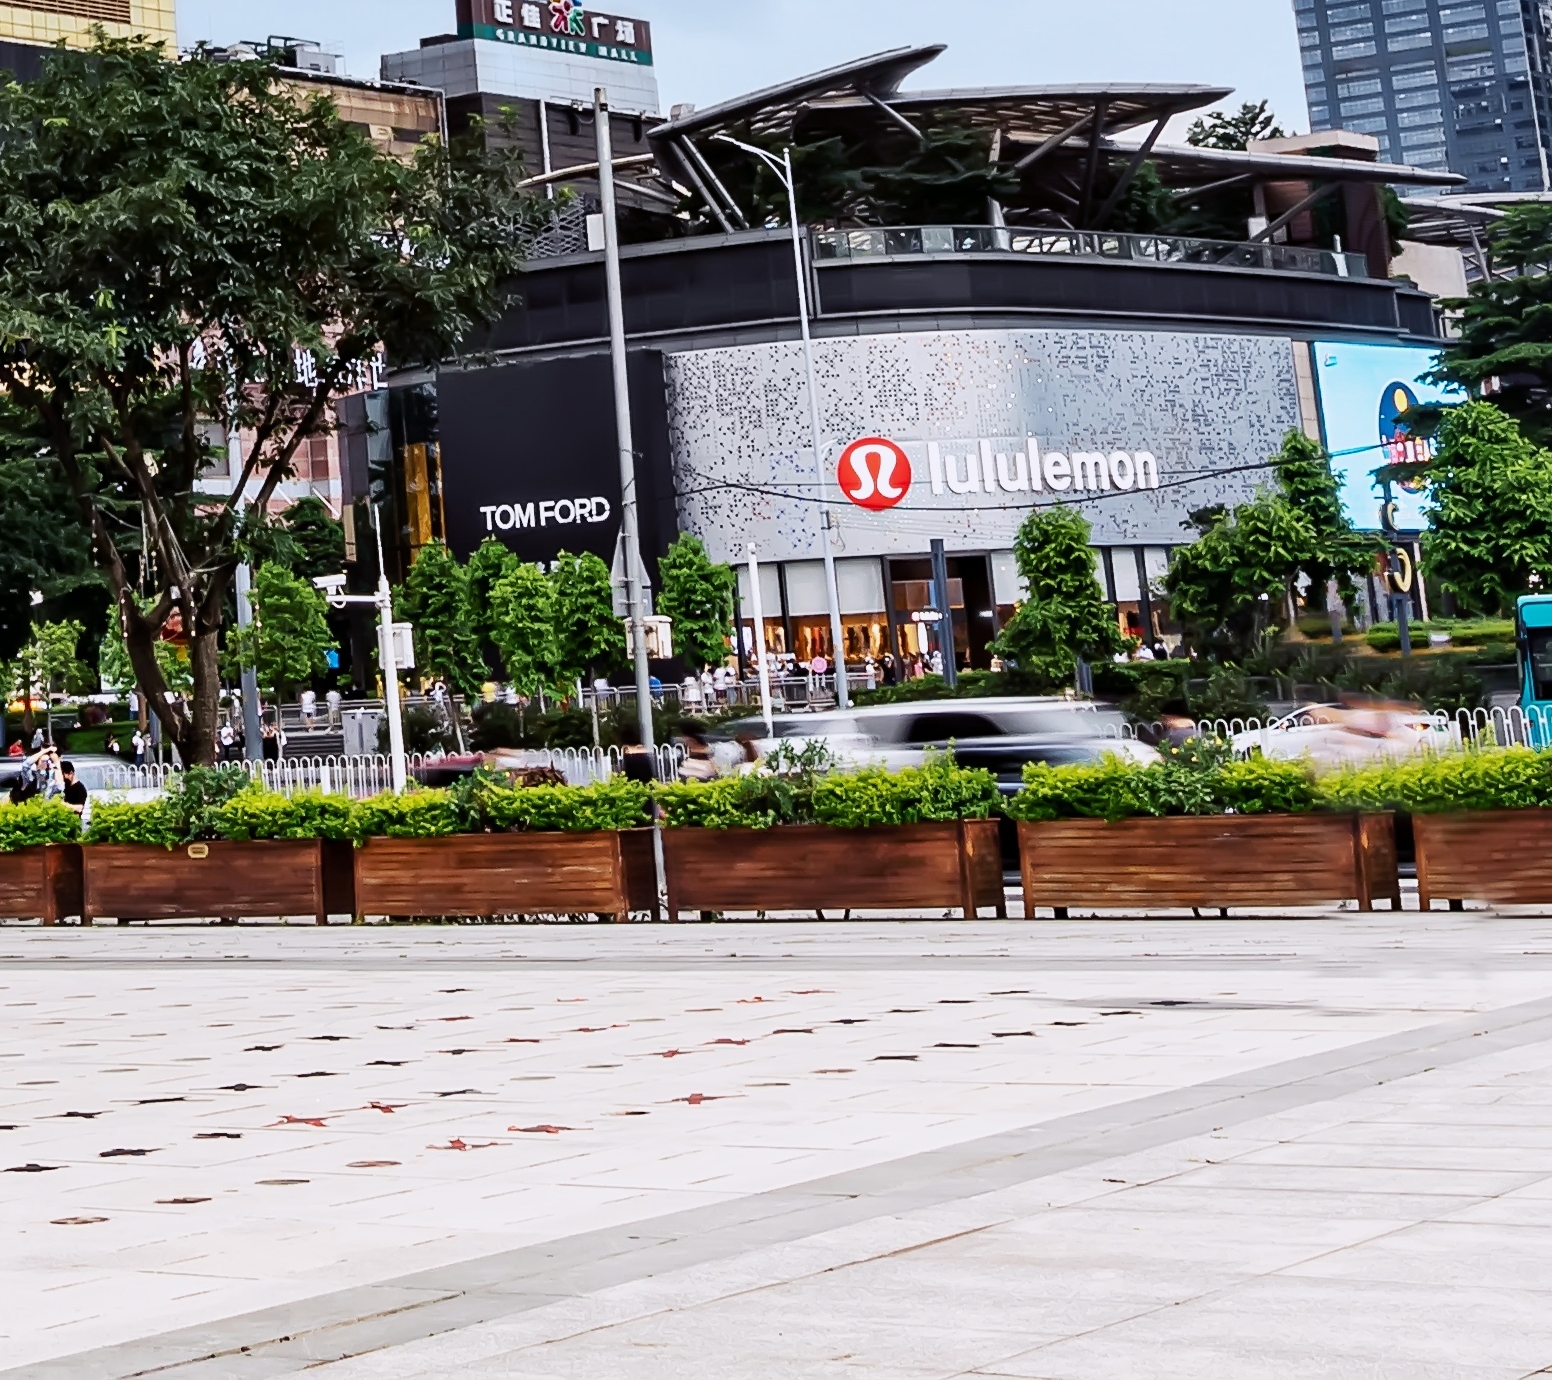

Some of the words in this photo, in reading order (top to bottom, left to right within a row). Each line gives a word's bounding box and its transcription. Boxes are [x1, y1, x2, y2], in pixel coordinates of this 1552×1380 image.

[495, 28, 587, 54] GRANDVIEW
[598, 45, 638, 62] MALL
[591, 16, 636, 45] 广场
[927, 437, 1159, 495] lululemon
[479, 501, 536, 531] TOM
[539, 496, 611, 527] FORD
